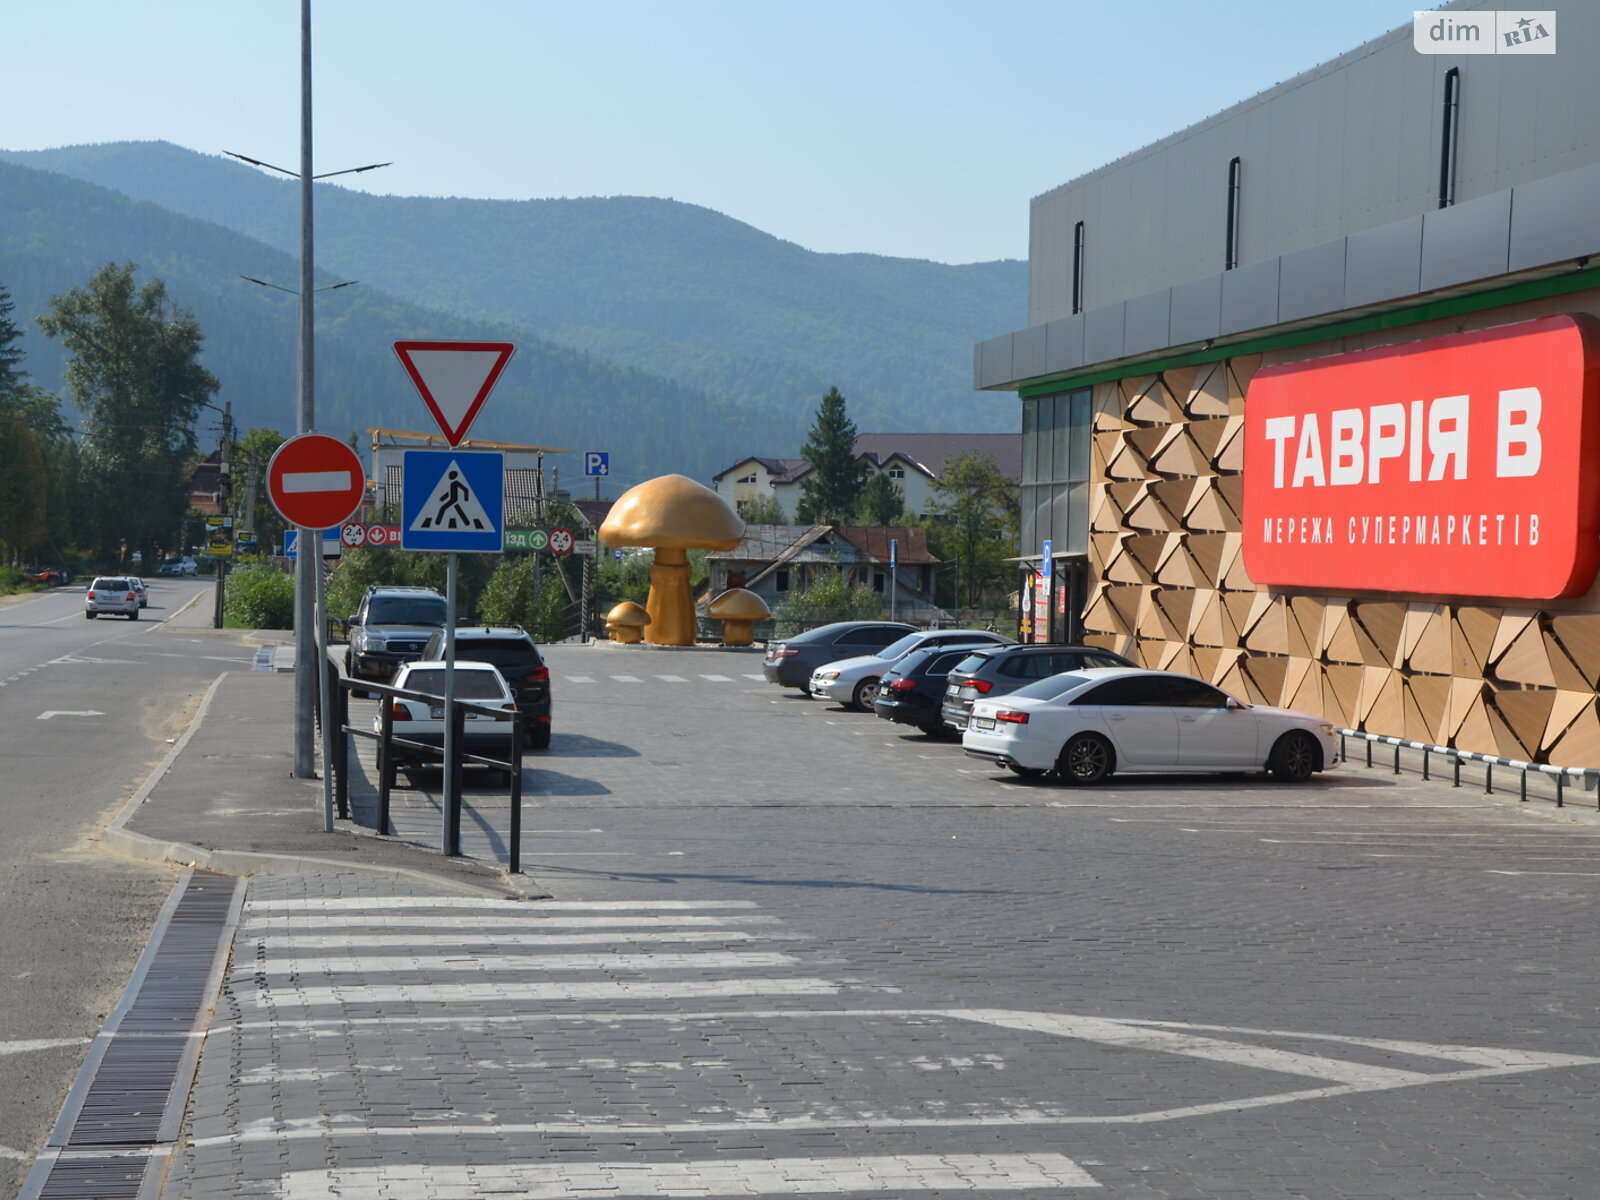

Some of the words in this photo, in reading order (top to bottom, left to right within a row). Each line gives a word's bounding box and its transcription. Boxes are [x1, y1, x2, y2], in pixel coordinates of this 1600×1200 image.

[1265, 394, 1470, 489] ТАВРІЯ
[1496, 386, 1543, 478] В
[588, 453, 602, 474] P
[1263, 517, 1334, 544] МЕРЕЖА
[1348, 514, 1540, 546] СУПЕРМАРКЕТІВ
